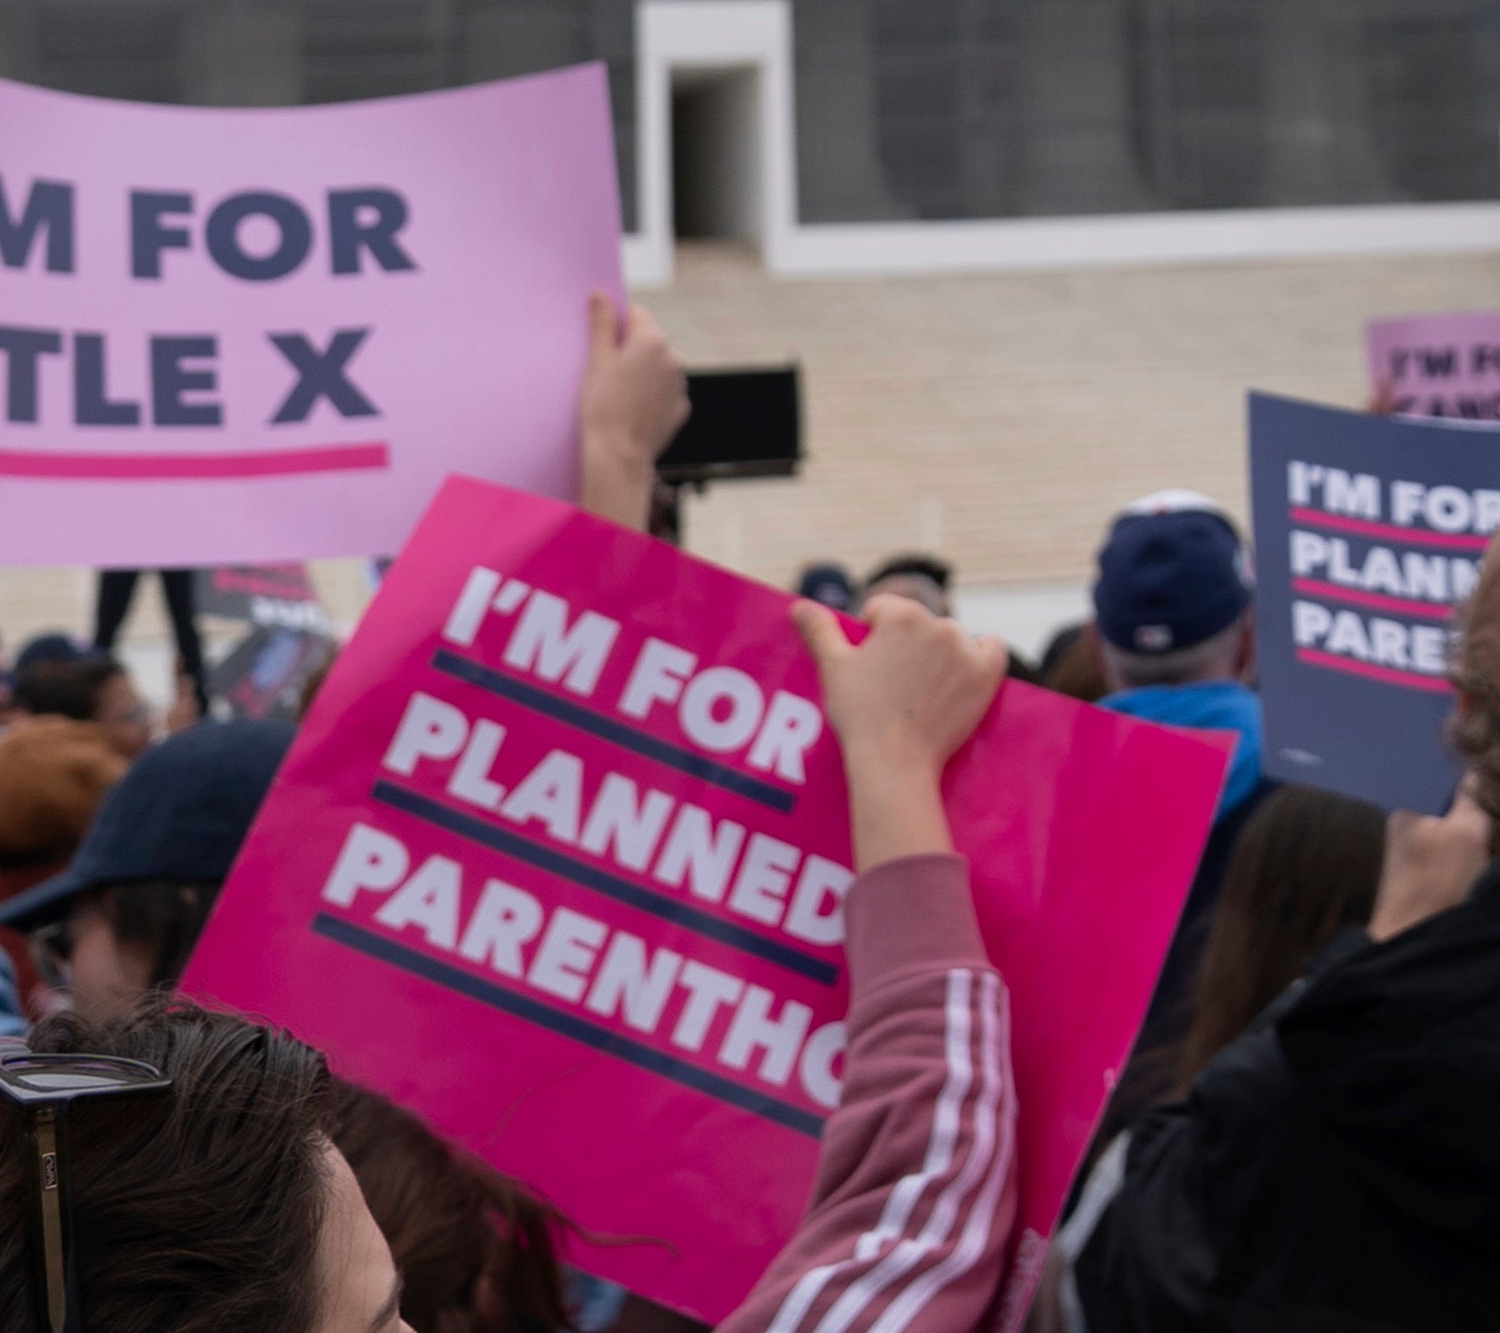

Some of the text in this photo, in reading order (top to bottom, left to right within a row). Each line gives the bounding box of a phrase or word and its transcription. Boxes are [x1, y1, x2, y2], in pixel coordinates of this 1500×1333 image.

[127, 185, 421, 284] FOR
[267, 326, 384, 427] X
[1287, 459, 1382, 520] I'M
[439, 564, 622, 699] I'M
[618, 636, 824, 785] FOR
[1291, 599, 1461, 676] PARE
[383, 691, 856, 946] PLANNED
